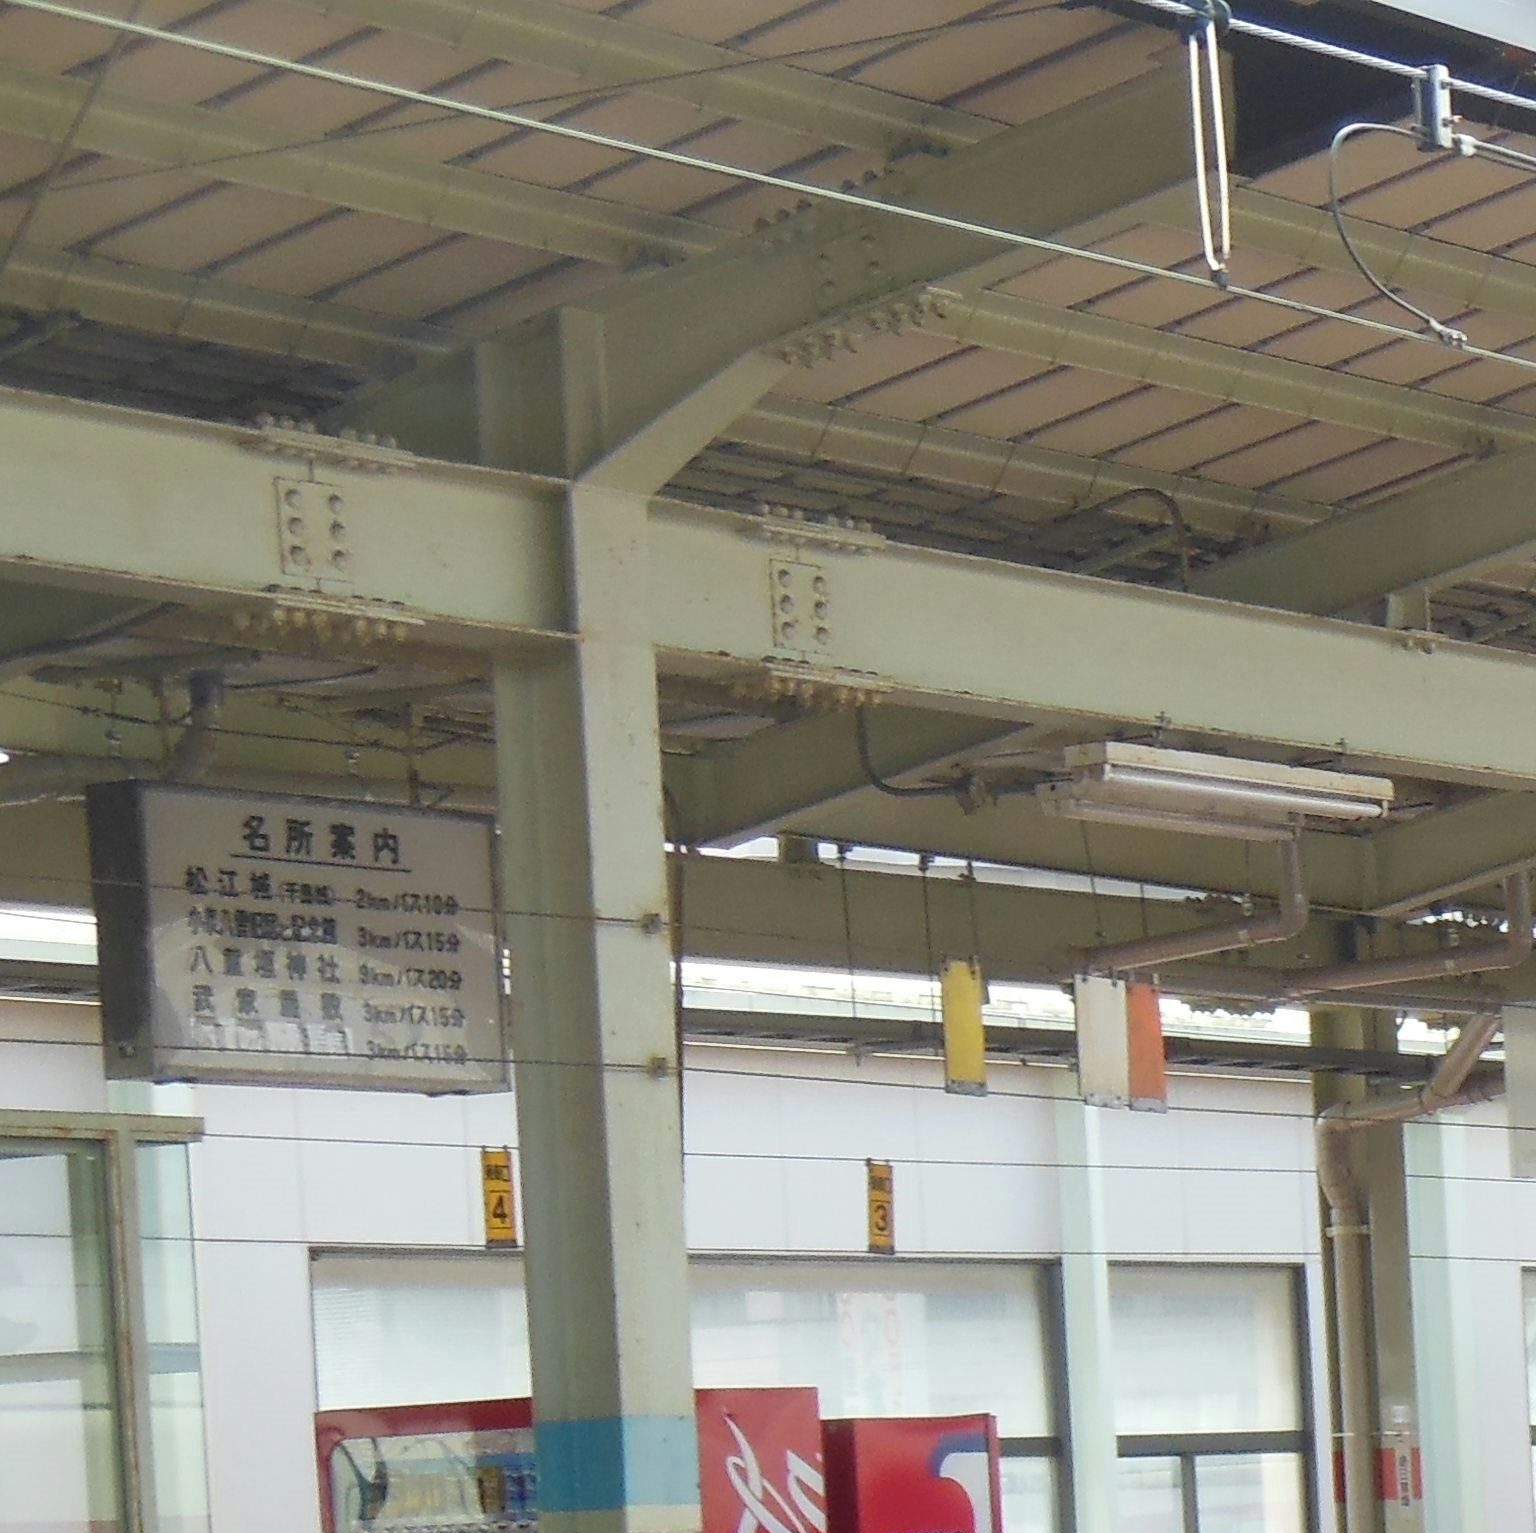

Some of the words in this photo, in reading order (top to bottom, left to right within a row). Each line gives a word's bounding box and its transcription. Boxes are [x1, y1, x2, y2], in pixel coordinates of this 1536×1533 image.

[242, 815, 399, 864] 名所案内
[493, 1194, 508, 1224] 4
[875, 1204, 888, 1232] 3
